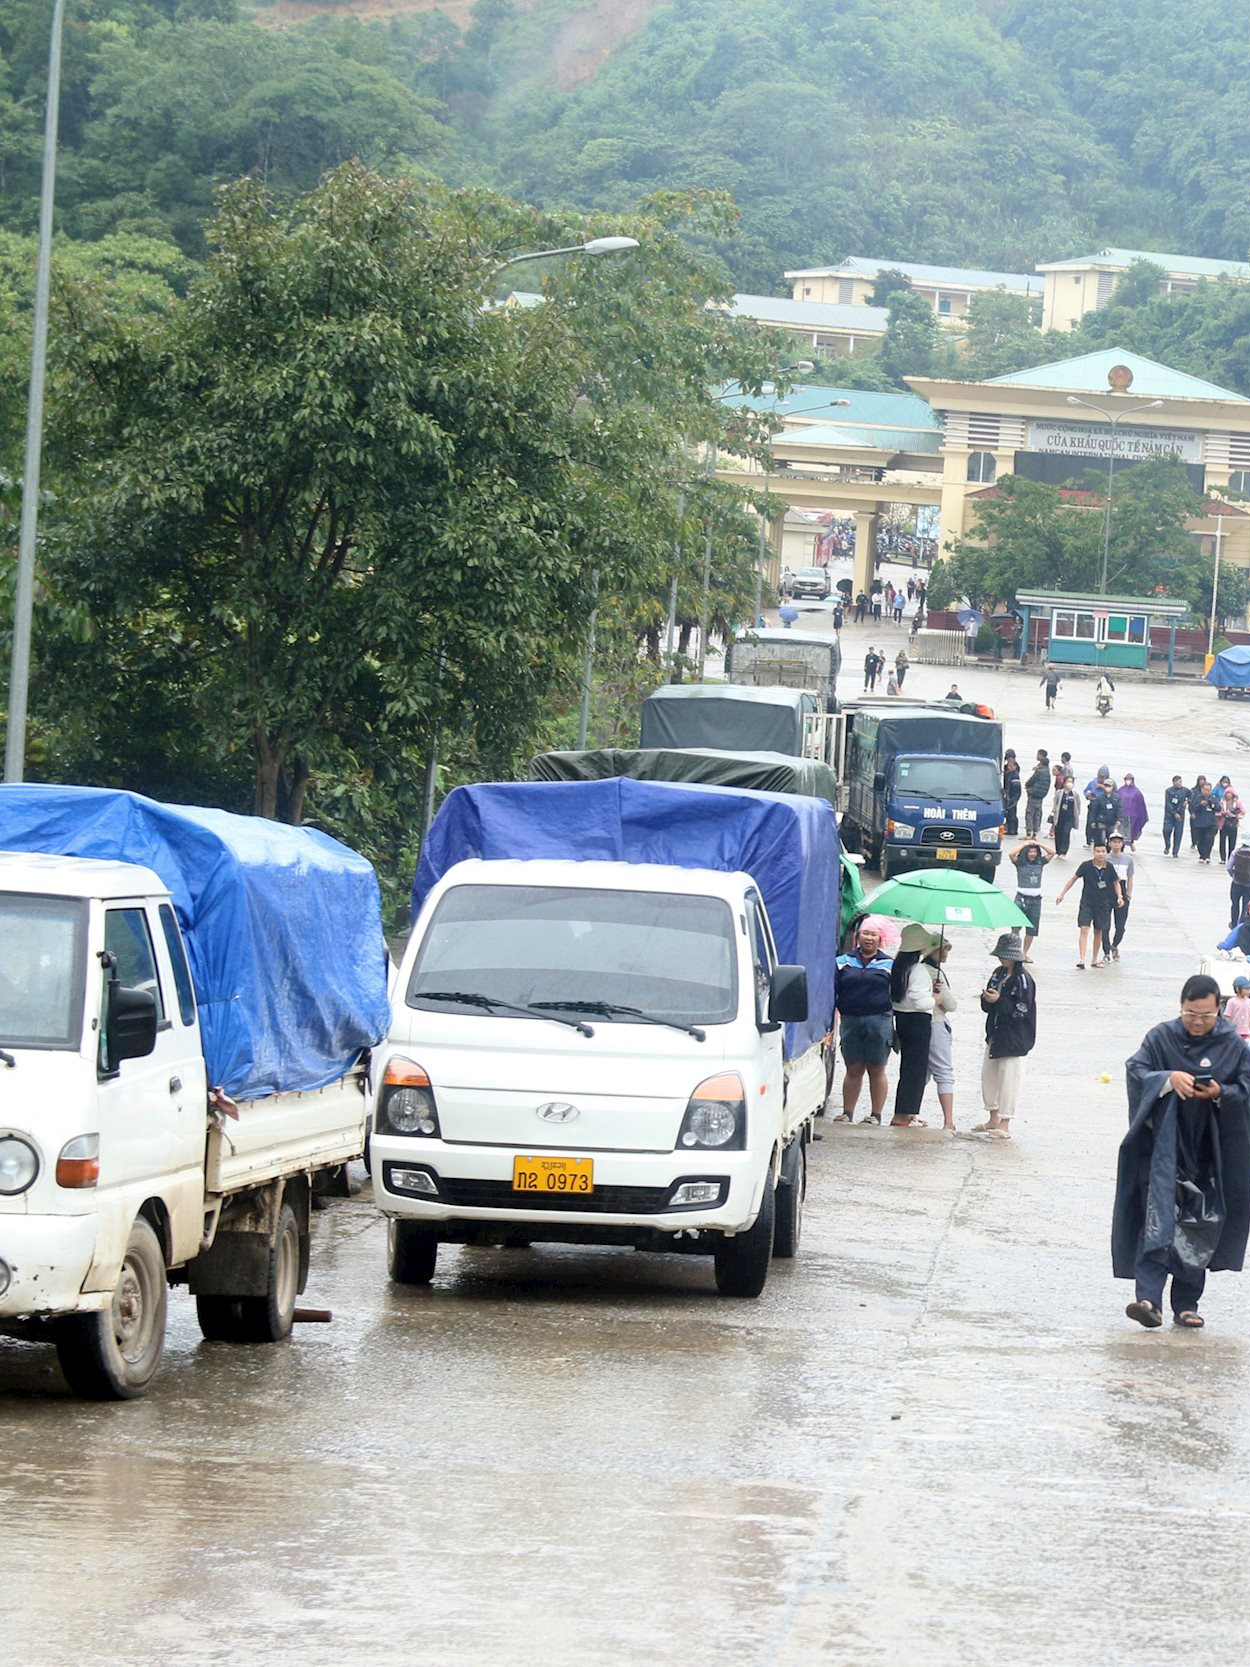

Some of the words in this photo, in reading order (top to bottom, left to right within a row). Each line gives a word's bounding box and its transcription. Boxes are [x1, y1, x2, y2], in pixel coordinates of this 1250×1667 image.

[923, 806, 946, 820] HOÀI
[951, 808, 977, 821] THÊM
[547, 1173, 589, 1191] 0973
